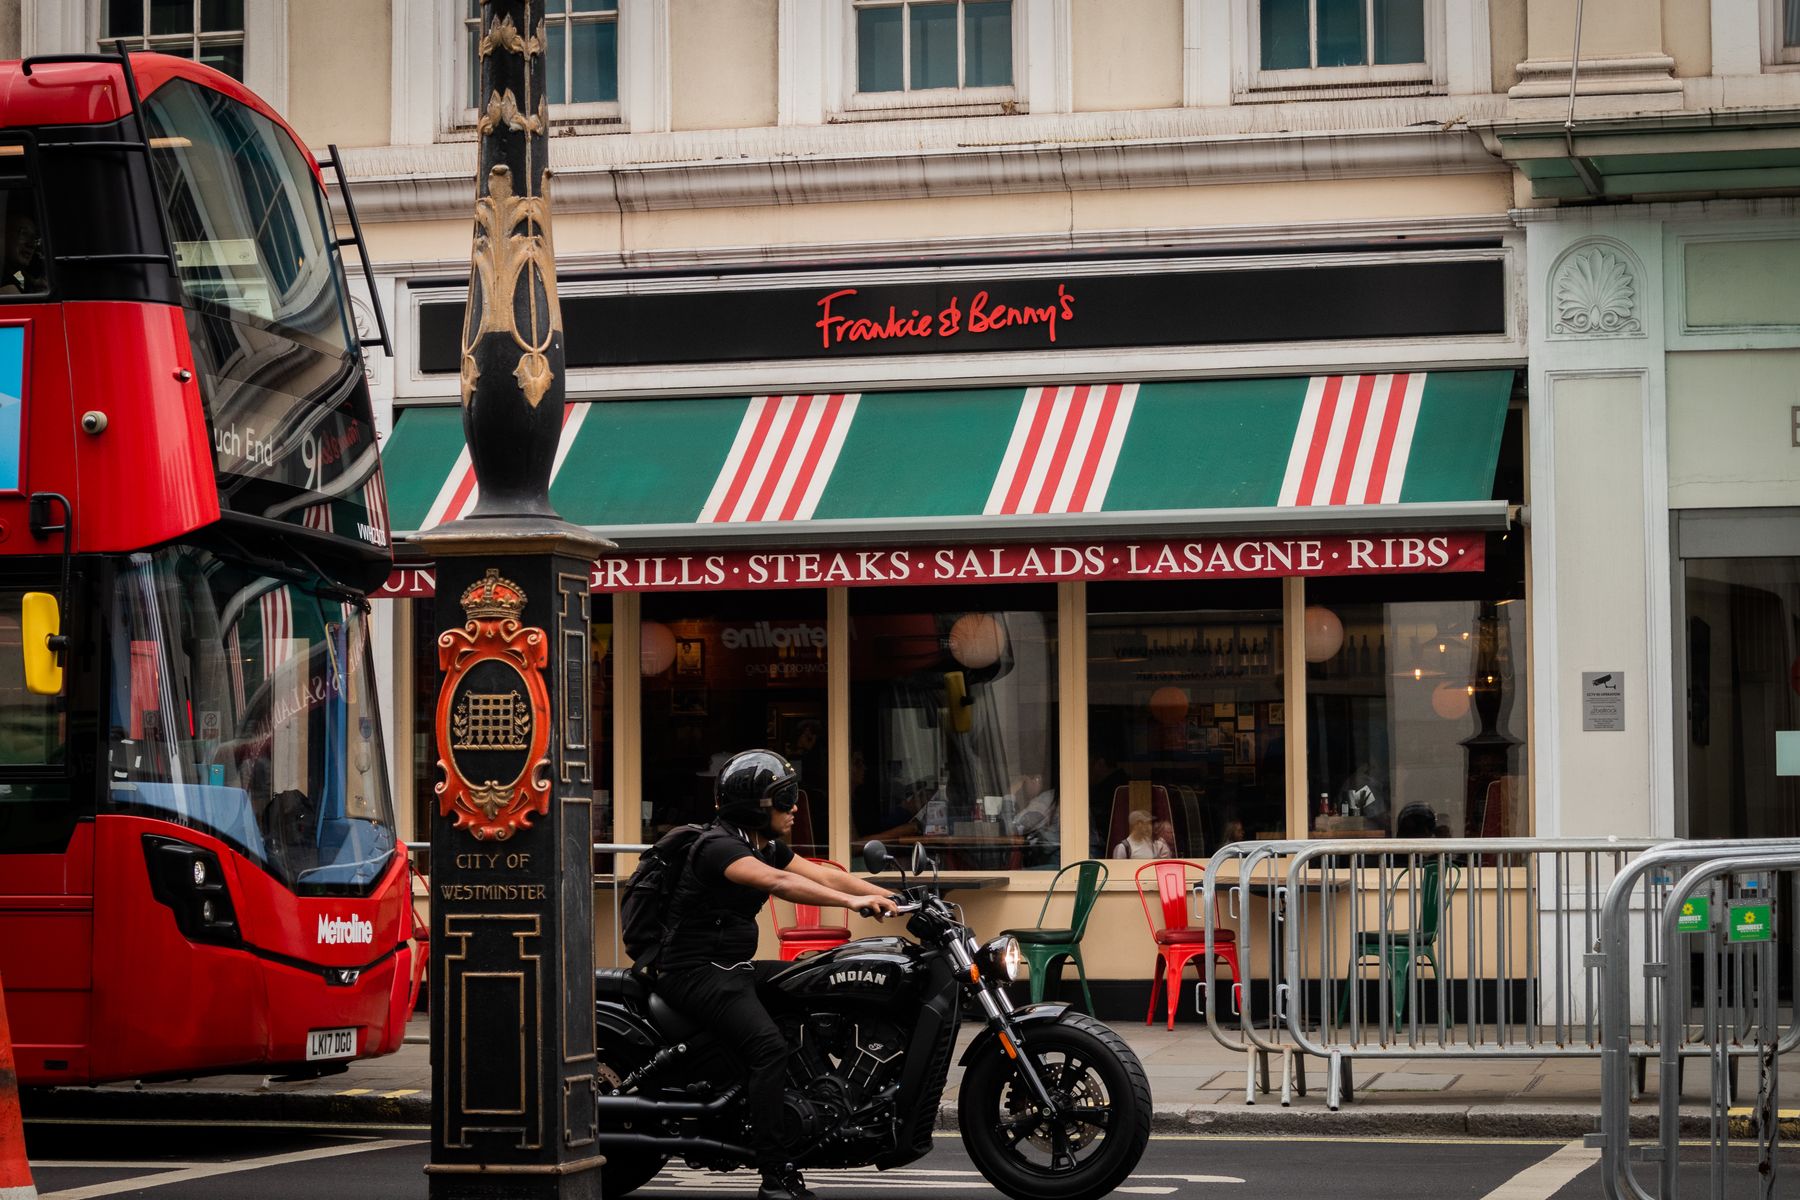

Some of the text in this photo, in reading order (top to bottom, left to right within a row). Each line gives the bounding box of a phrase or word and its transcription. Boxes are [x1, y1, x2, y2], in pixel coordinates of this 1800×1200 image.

[816, 284, 1075, 348] Frankie & Benny's
[246, 427, 273, 467] End
[302, 430, 322, 493] 91
[748, 550, 910, 583] STEAKS
[934, 546, 1105, 579] SALADS
[1126, 540, 1324, 575] LASAGNE
[1347, 536, 1449, 570] RIBS
[456, 853, 531, 869] CITY OF
[440, 884, 547, 900] WESTMINSTER
[317, 913, 373, 945] Metroline
[829, 970, 886, 985] INDIAN
[312, 1031, 352, 1056] LK17 DGO
